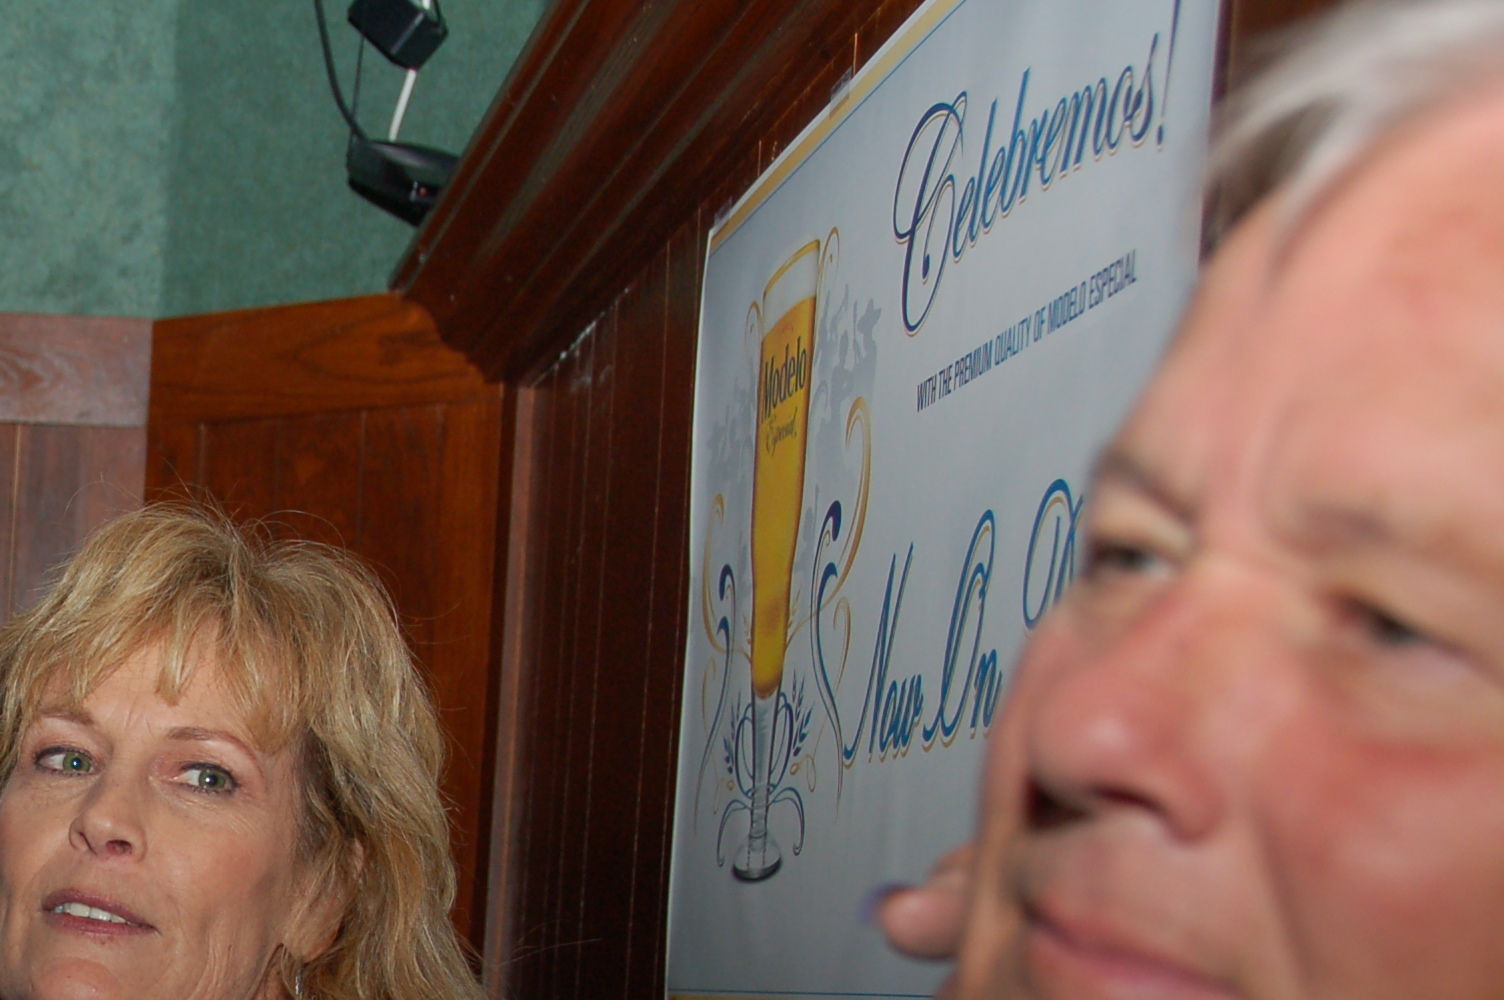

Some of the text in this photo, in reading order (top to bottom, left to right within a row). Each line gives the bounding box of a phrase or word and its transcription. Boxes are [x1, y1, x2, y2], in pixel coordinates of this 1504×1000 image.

[893, 0, 1181, 338] Celebremos!
[760, 335, 807, 425] Modelo
[917, 249, 1137, 413] WITH THE PREMIUM QUALITY OF MODELO ESPECIAL
[843, 541, 924, 767] Now
[923, 509, 1003, 750] On
